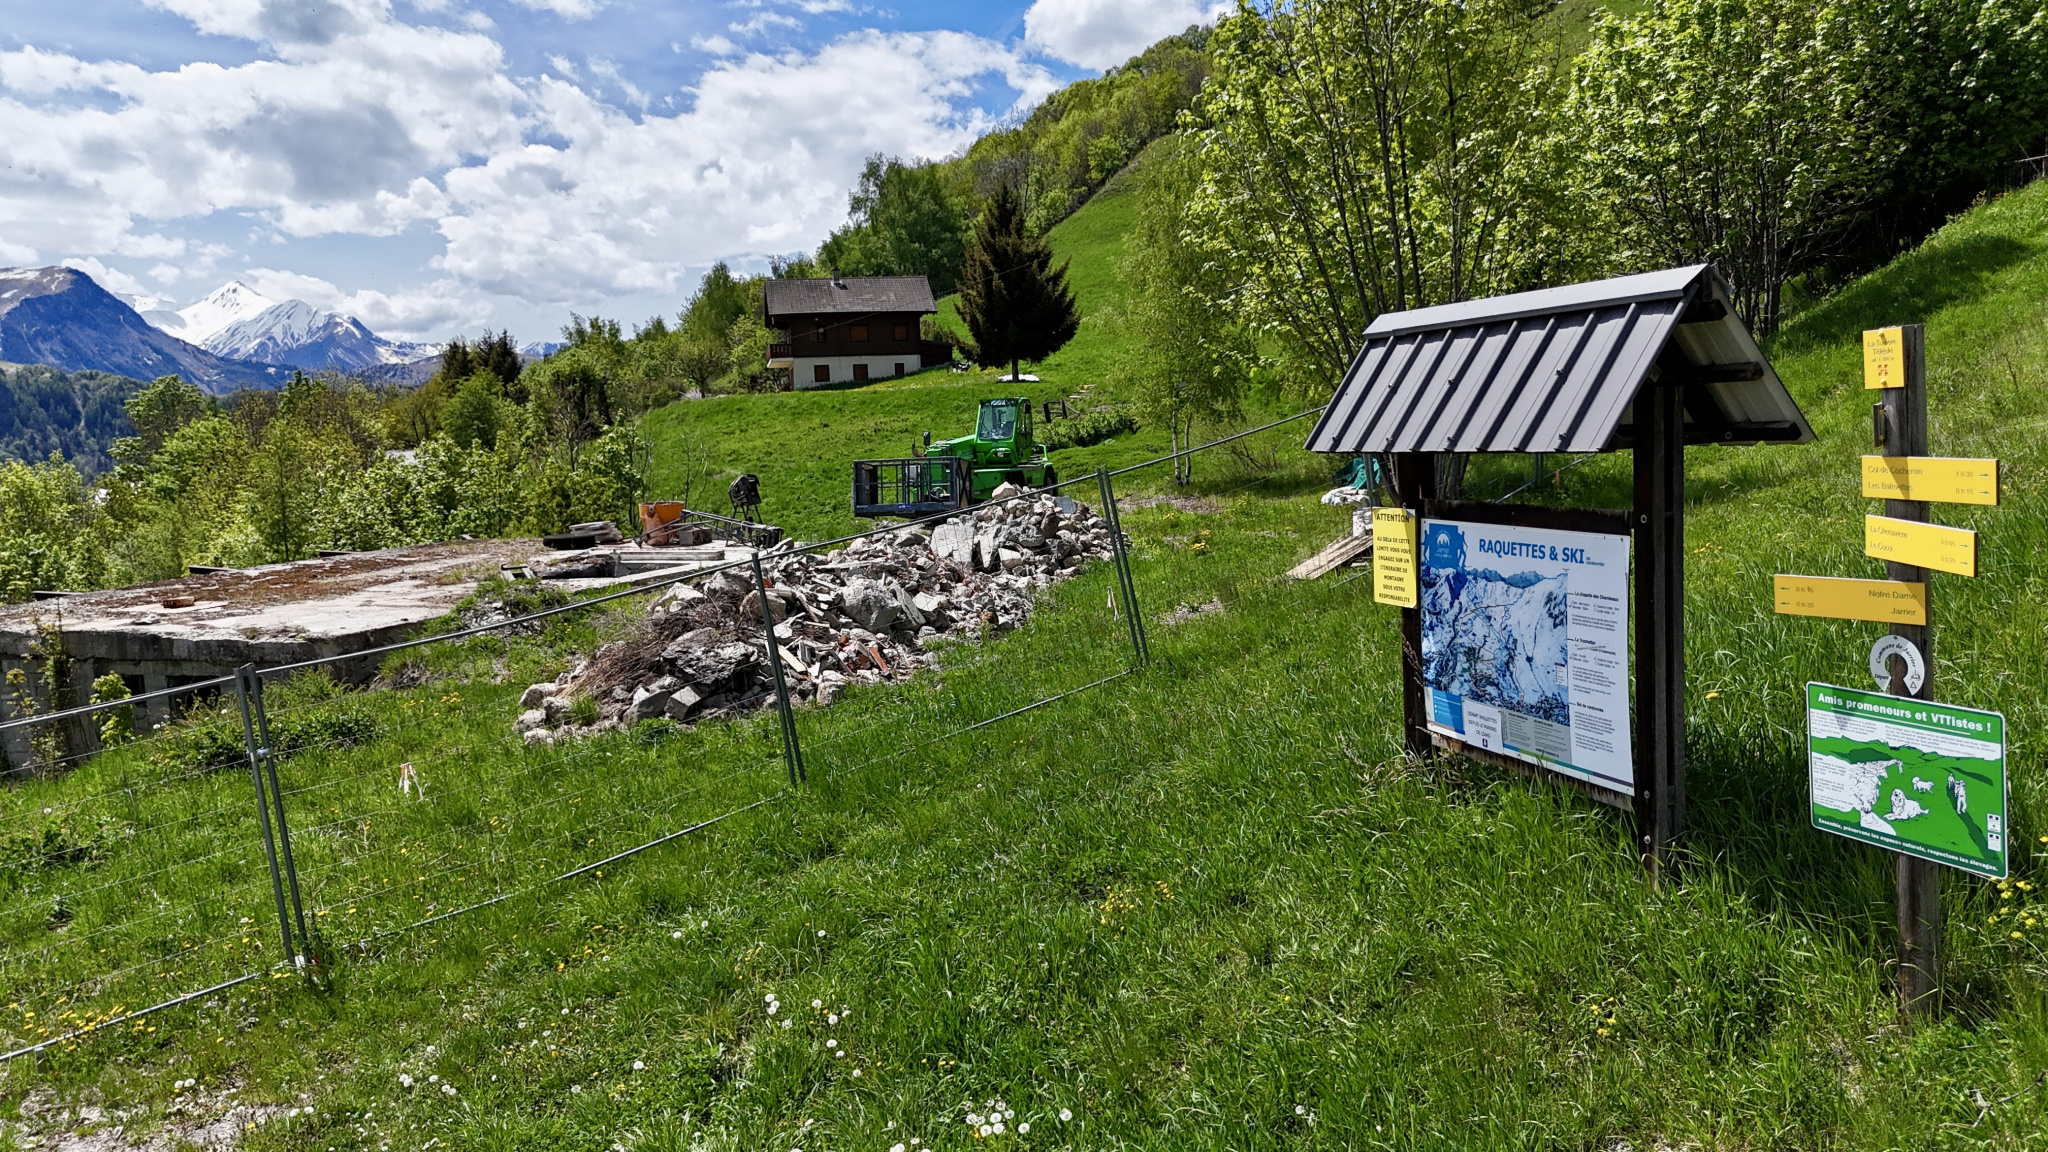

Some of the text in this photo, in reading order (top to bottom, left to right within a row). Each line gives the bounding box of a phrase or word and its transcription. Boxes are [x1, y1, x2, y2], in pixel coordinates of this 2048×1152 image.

[1376, 513, 1410, 523] ATTENTION
[1479, 538, 1584, 564] RAQUETTES & SKI
[1869, 590, 1916, 599] Notre Dame
[1876, 643, 1894, 664] Commune
[1903, 648, 1916, 668] Jarrier
[1818, 693, 1991, 733] Amis promeneurs et VTTistes !
[1818, 818, 1843, 830] Ensemble,
[1843, 825, 1870, 837] préservons
[1880, 835, 1901, 846] espaces
[1902, 841, 1927, 853] naturels,
[1927, 848, 1959, 861] respectons
[1959, 856, 1969, 864] les
[1970, 859, 1998, 872] élevages.
